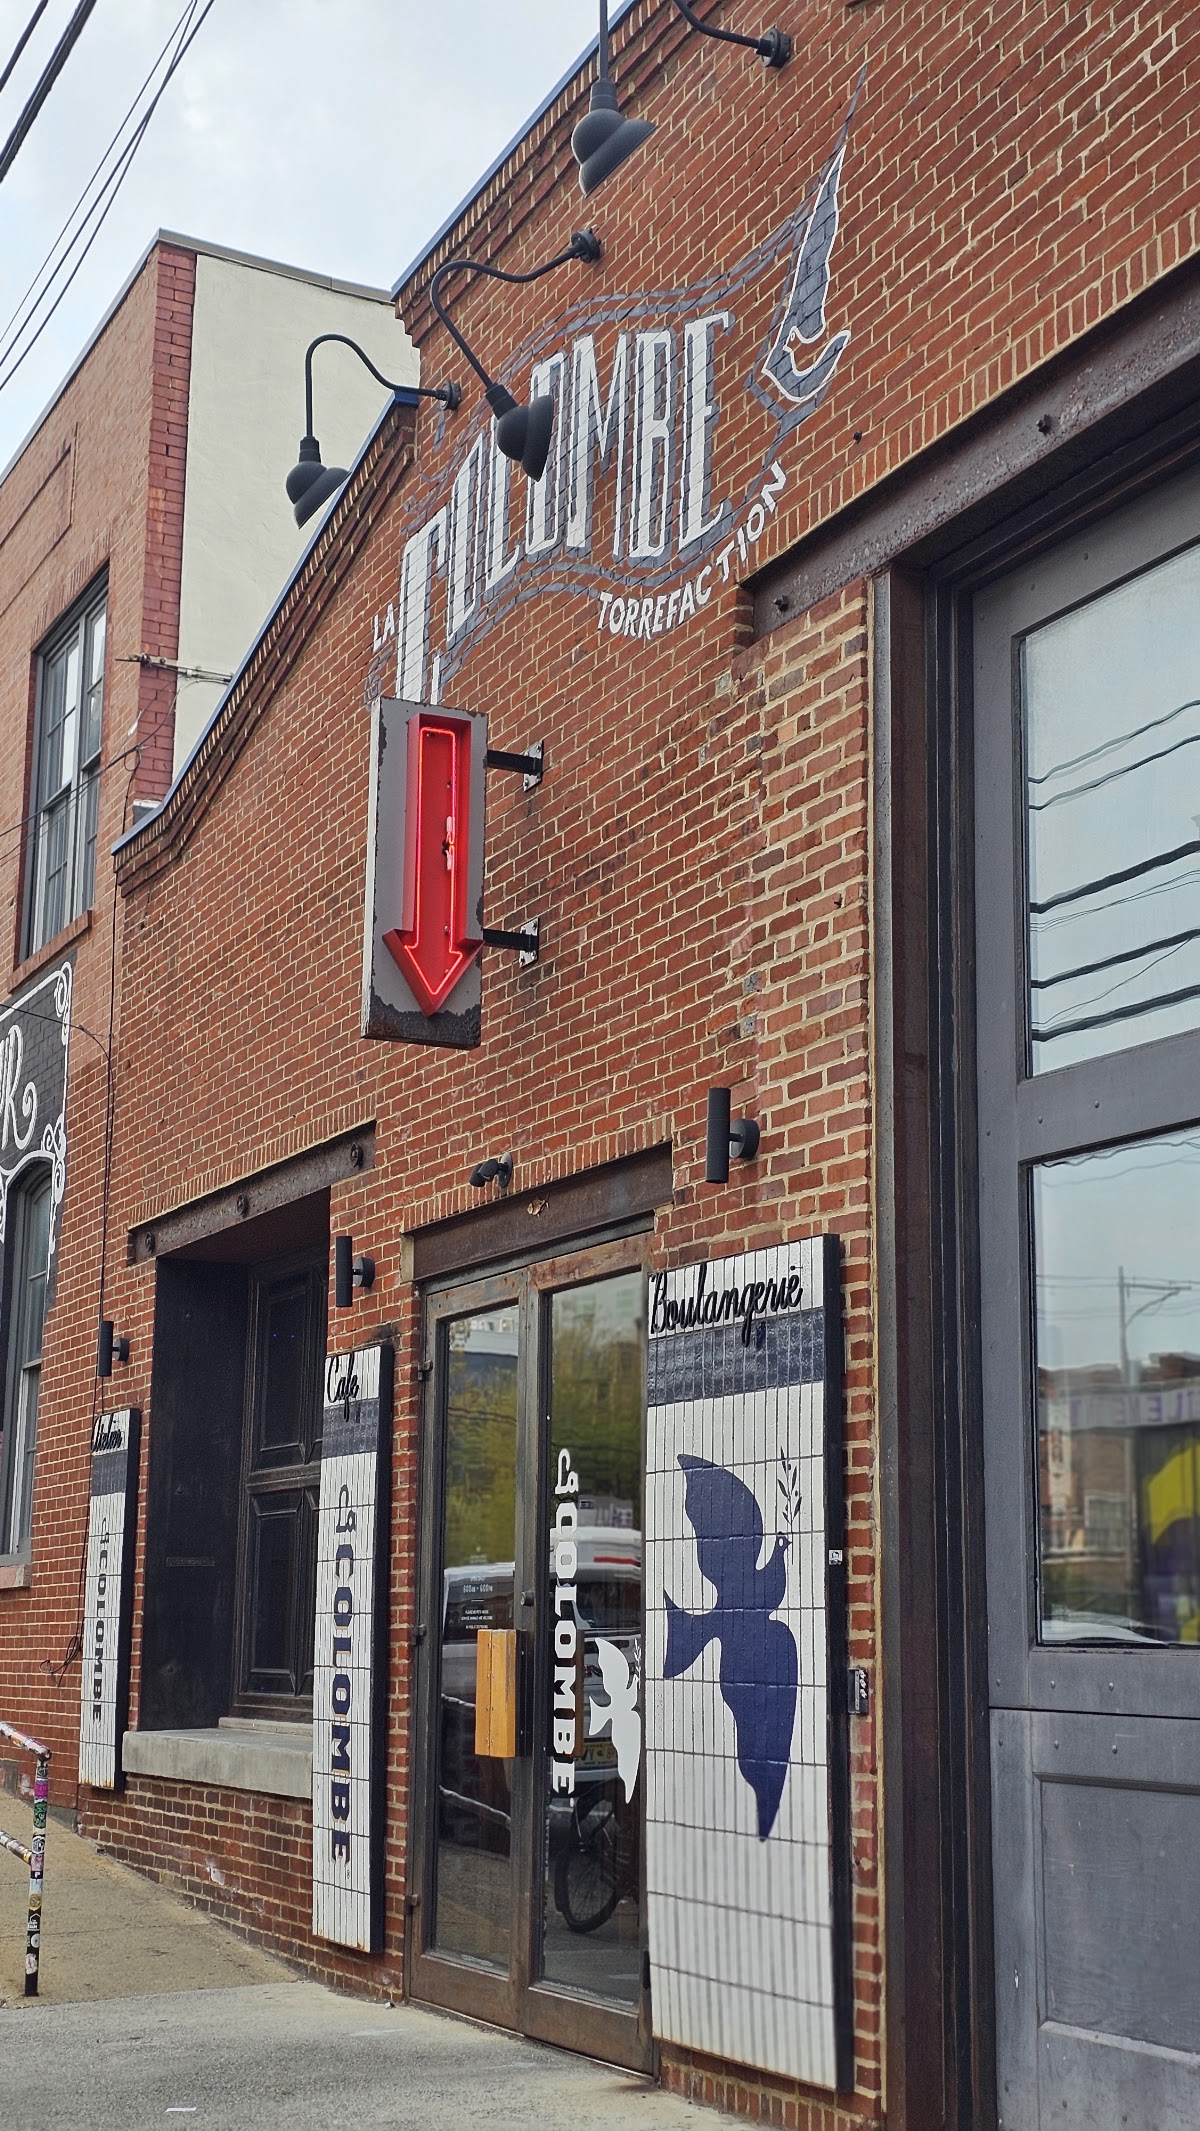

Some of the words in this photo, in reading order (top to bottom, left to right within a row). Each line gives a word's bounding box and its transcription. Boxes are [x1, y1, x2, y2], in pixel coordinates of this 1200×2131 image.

[373, 603, 398, 653] LA
[598, 461, 787, 640] TORREFACTION
[649, 1261, 804, 1348] Boulangerie
[92, 1548, 109, 1725] COLOMBE
[331, 1544, 354, 1865] COLOMBE
[551, 1501, 578, 1795] COLOMBE
